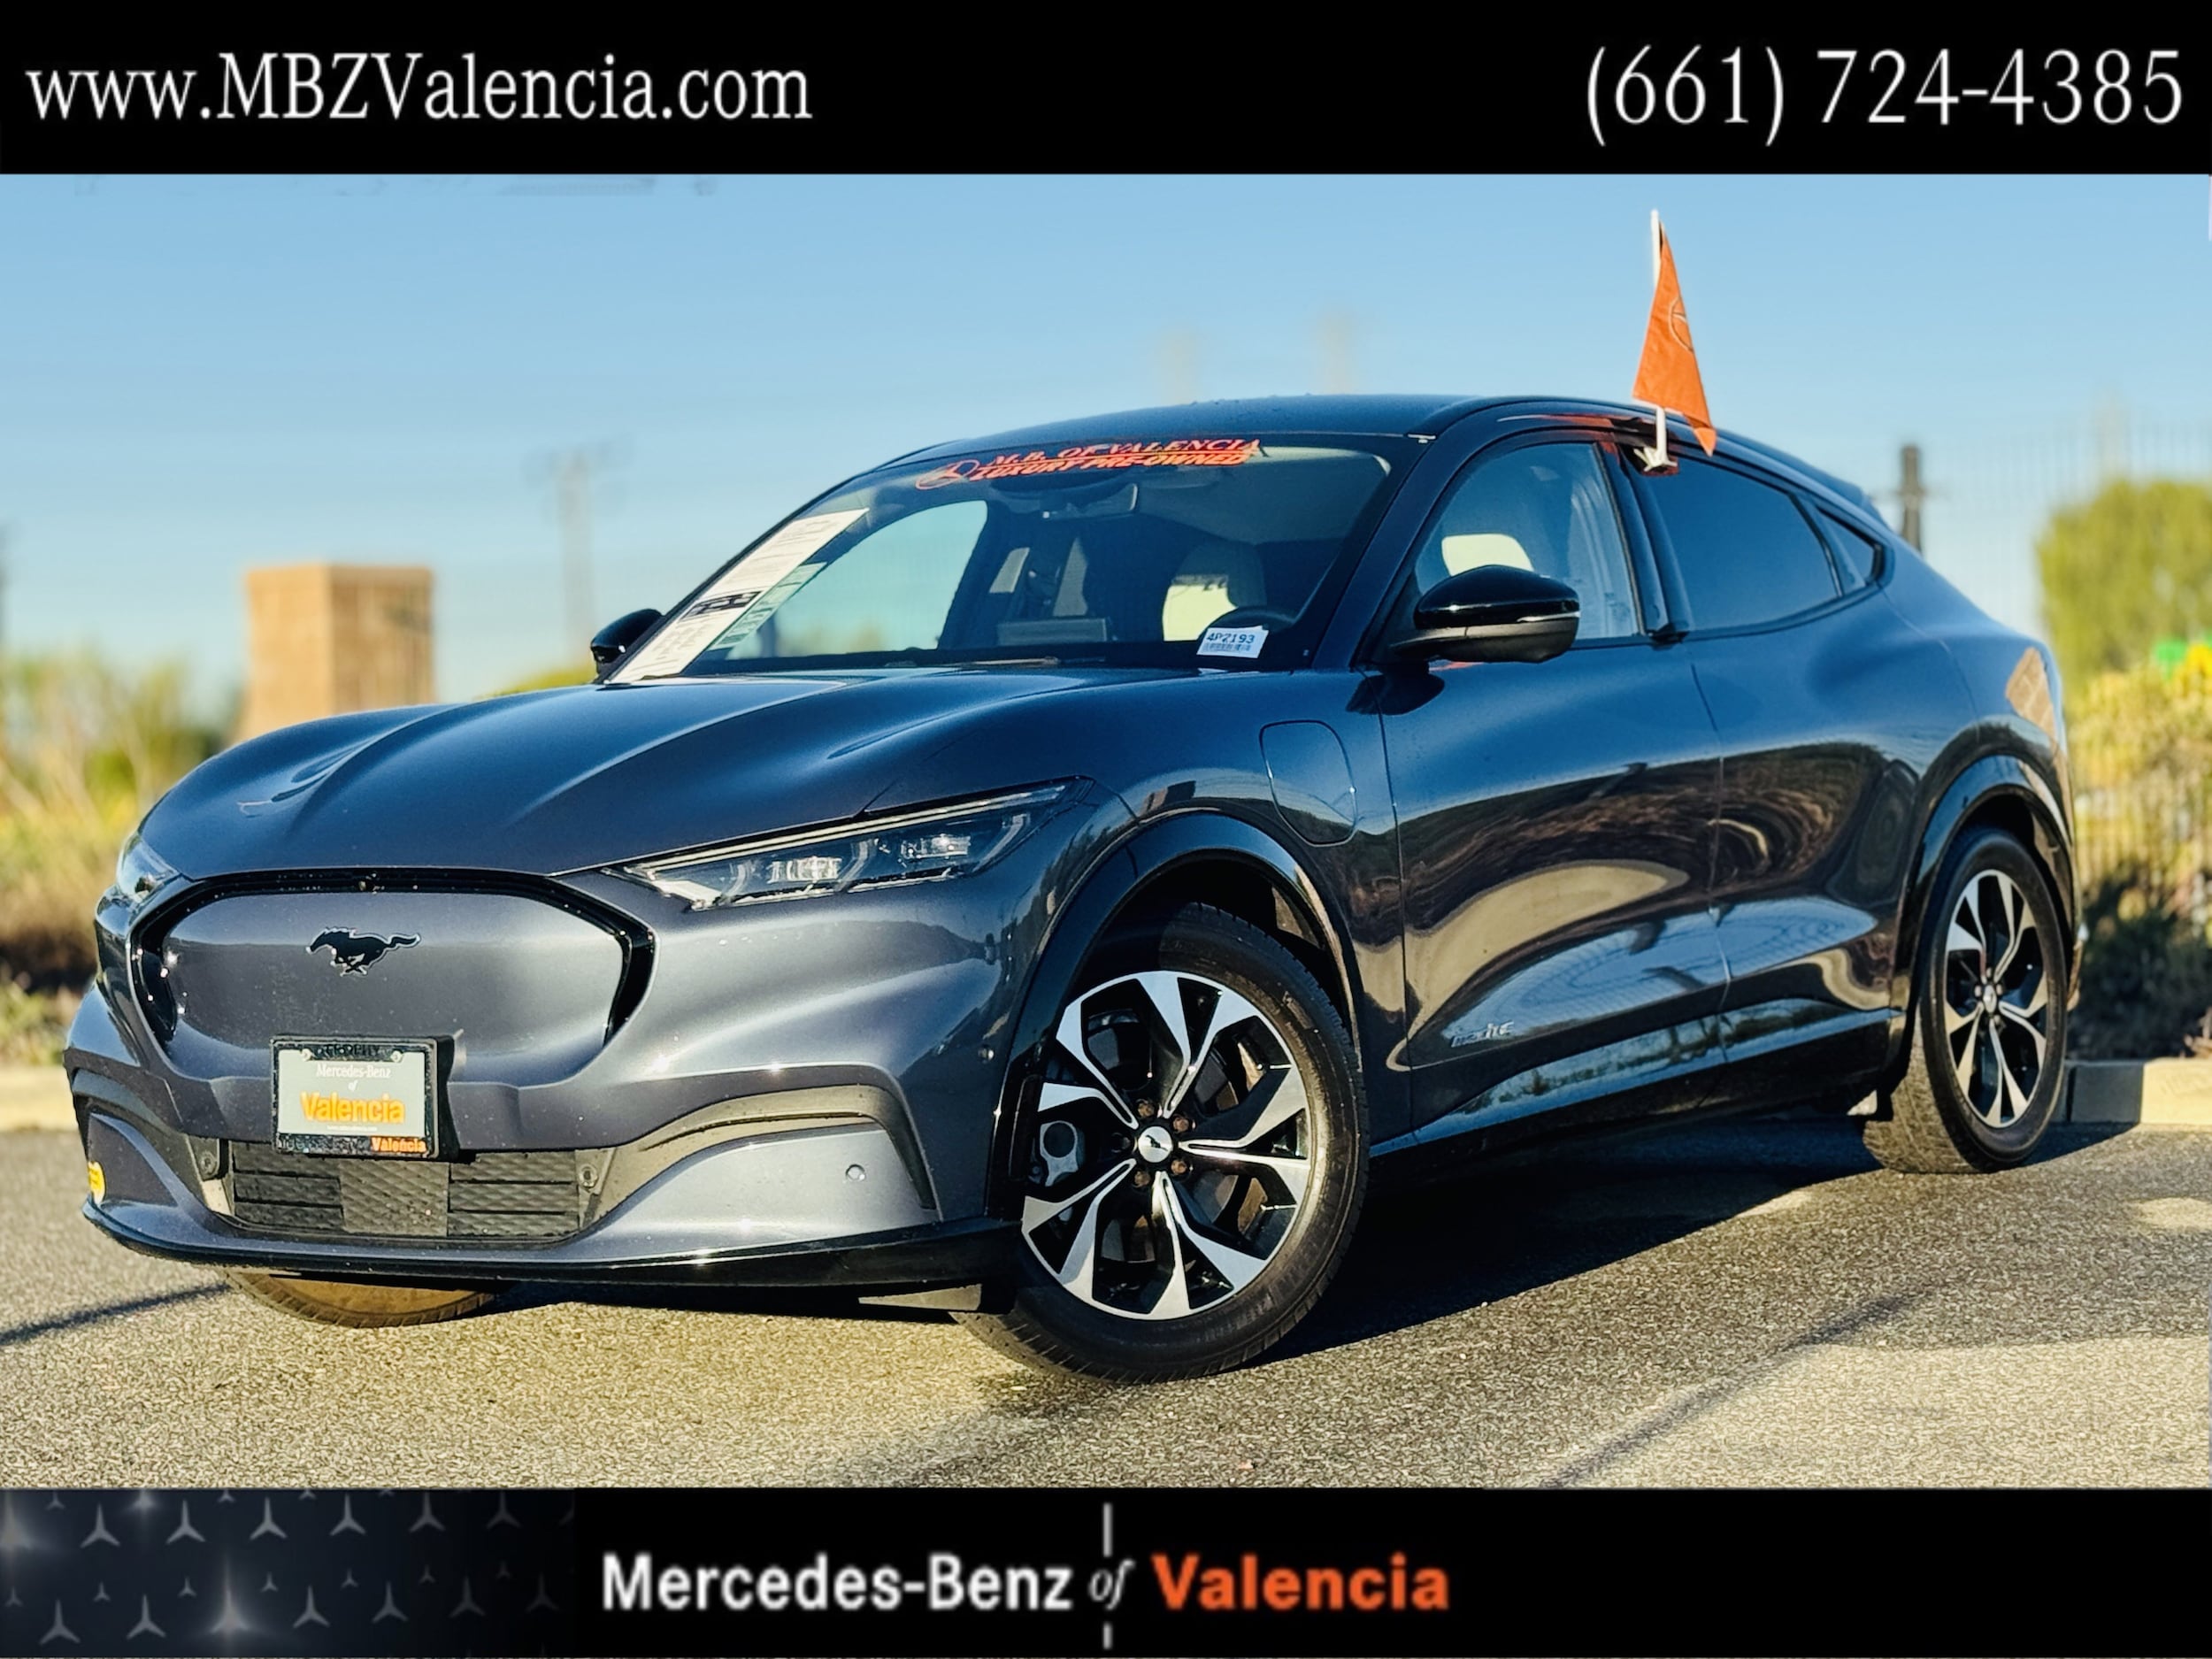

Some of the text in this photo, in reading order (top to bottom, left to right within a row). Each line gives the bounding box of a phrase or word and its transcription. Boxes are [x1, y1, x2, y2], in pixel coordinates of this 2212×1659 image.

[1057, 444, 1110, 457] OF
[1110, 439, 1262, 455] VALENCIA
[969, 454, 1250, 481] LUXURY PRE-OWNED
[1206, 632, 1256, 644] 4P2193
[316, 1064, 391, 1078] Mercedes-Benz
[348, 1079, 358, 1091] of
[300, 1091, 405, 1123] Valencia
[371, 1136, 426, 1153] Valencia
